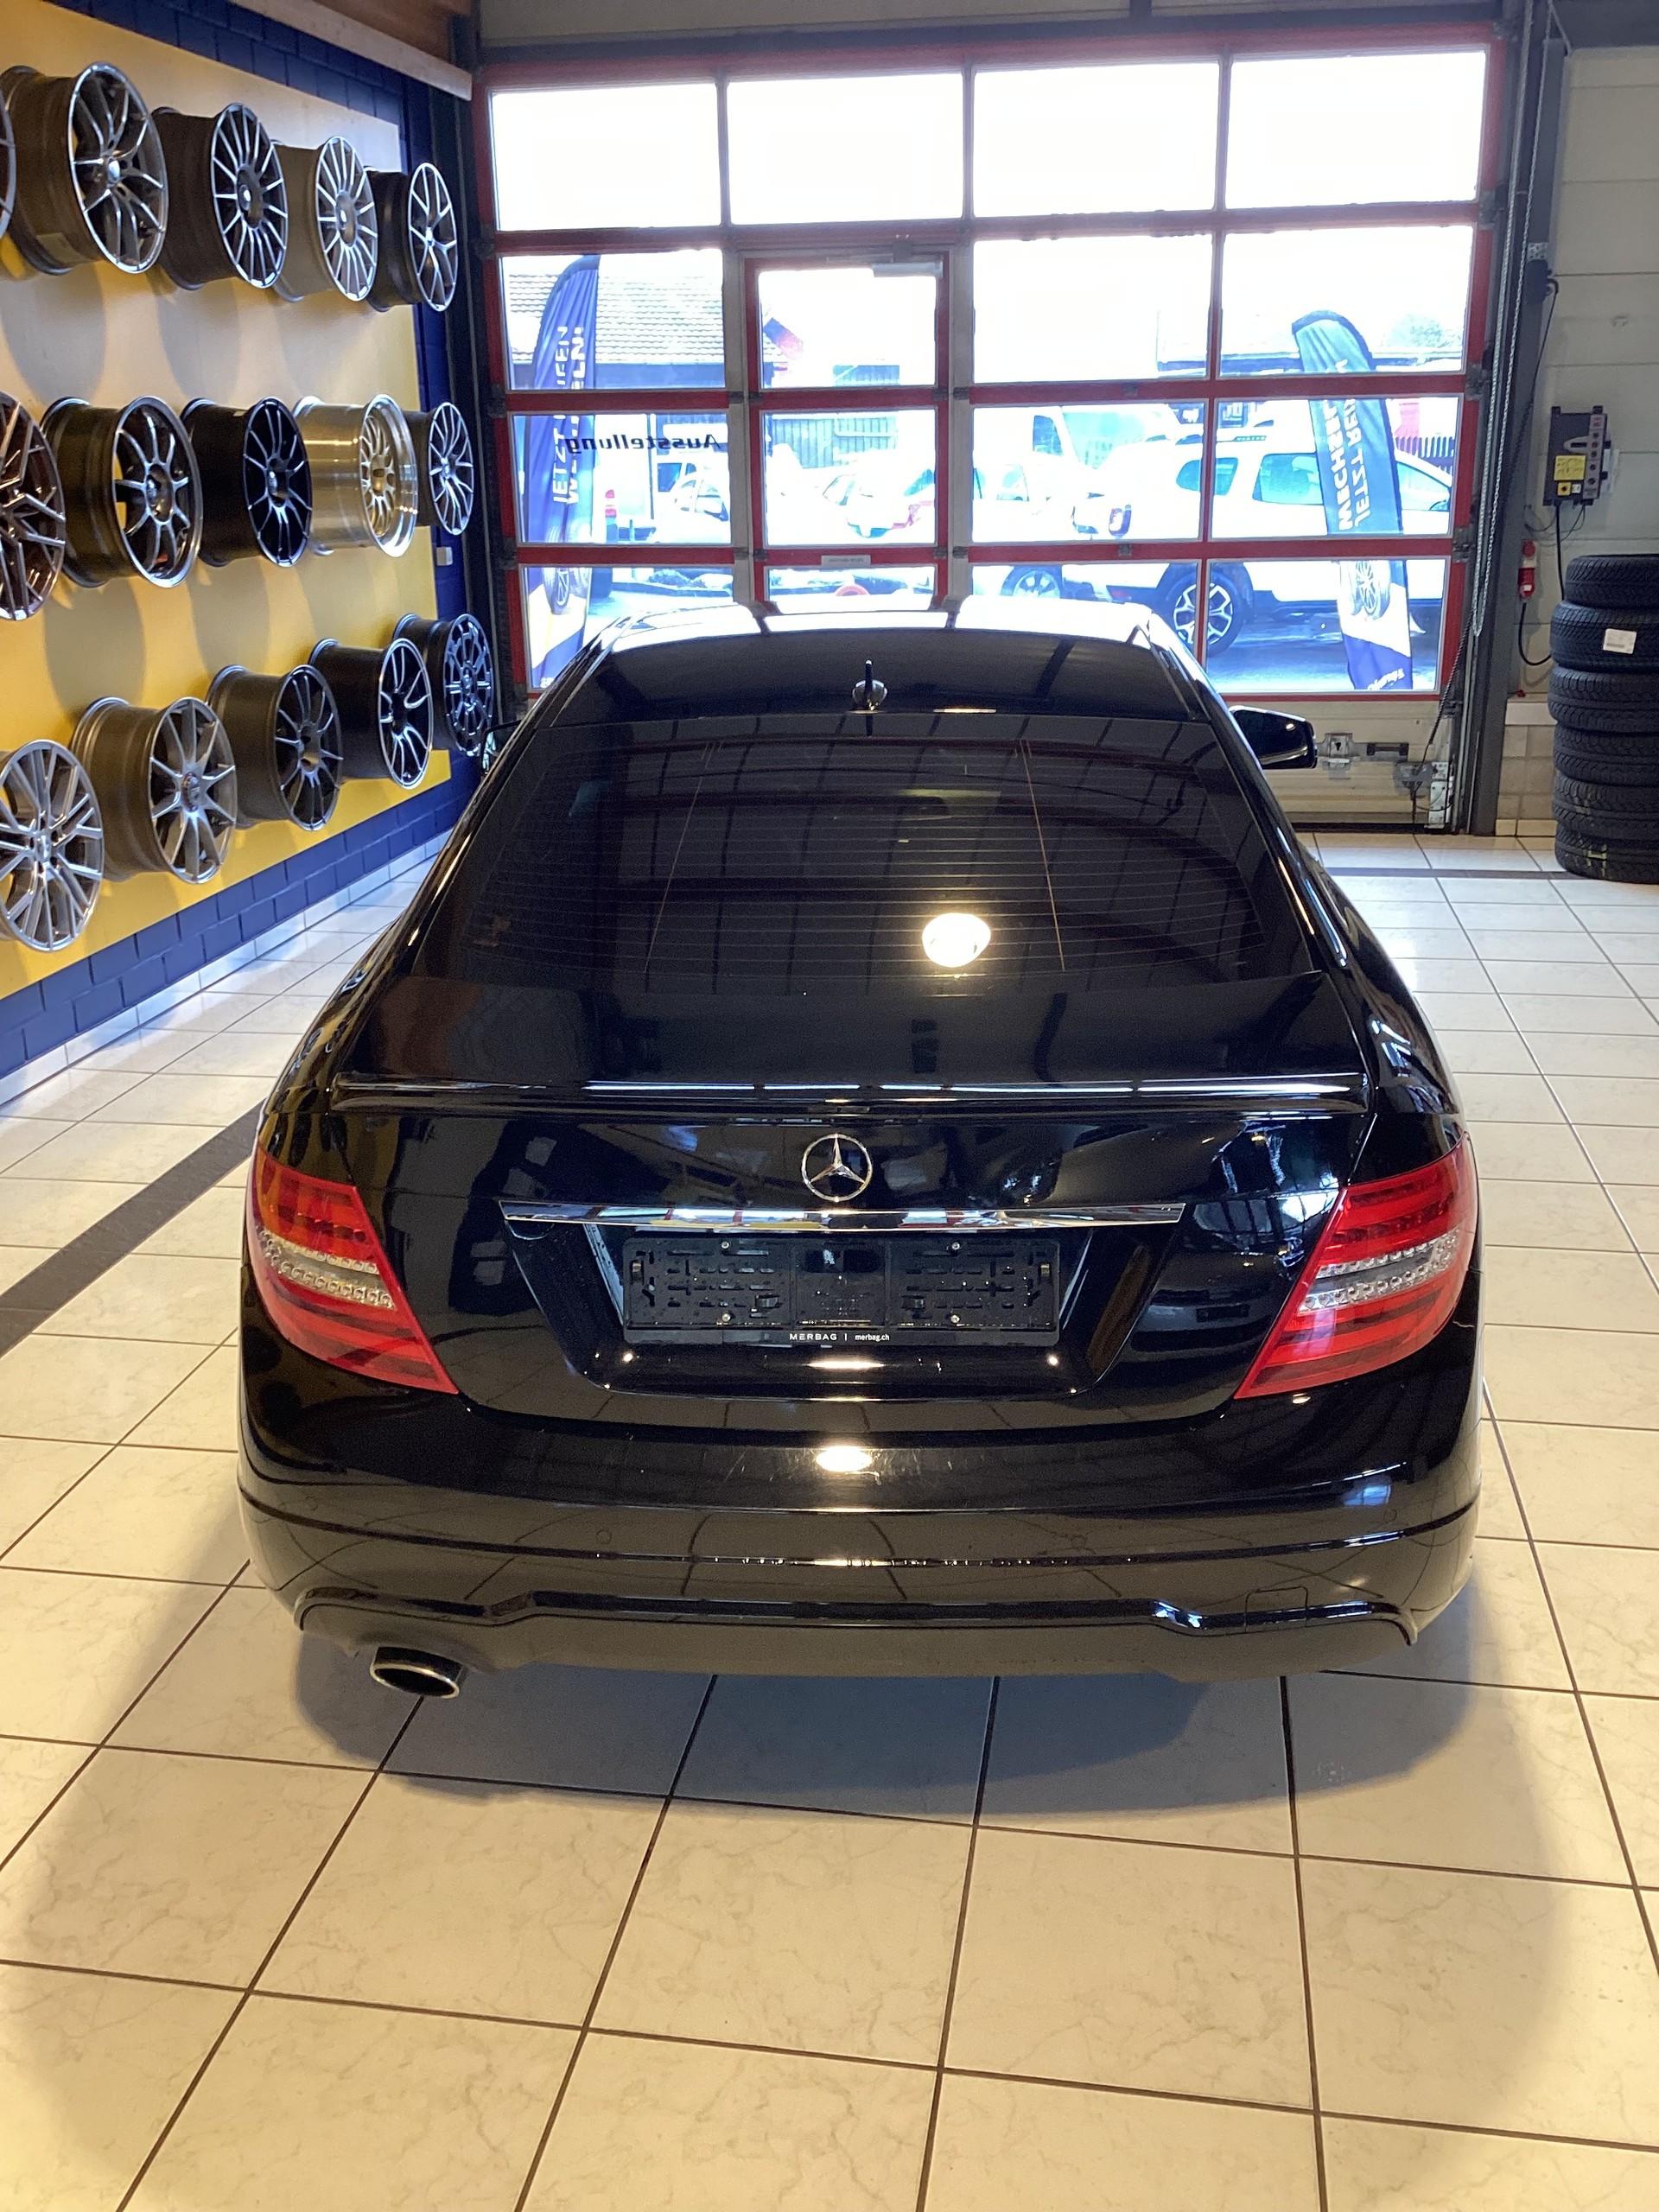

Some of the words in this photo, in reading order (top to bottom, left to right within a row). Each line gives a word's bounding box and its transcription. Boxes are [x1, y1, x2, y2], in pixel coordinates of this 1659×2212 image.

[554, 326, 570, 420] IFEN
[553, 428, 569, 504] JETZT
[855, 1333, 890, 1342] merbag.ch
